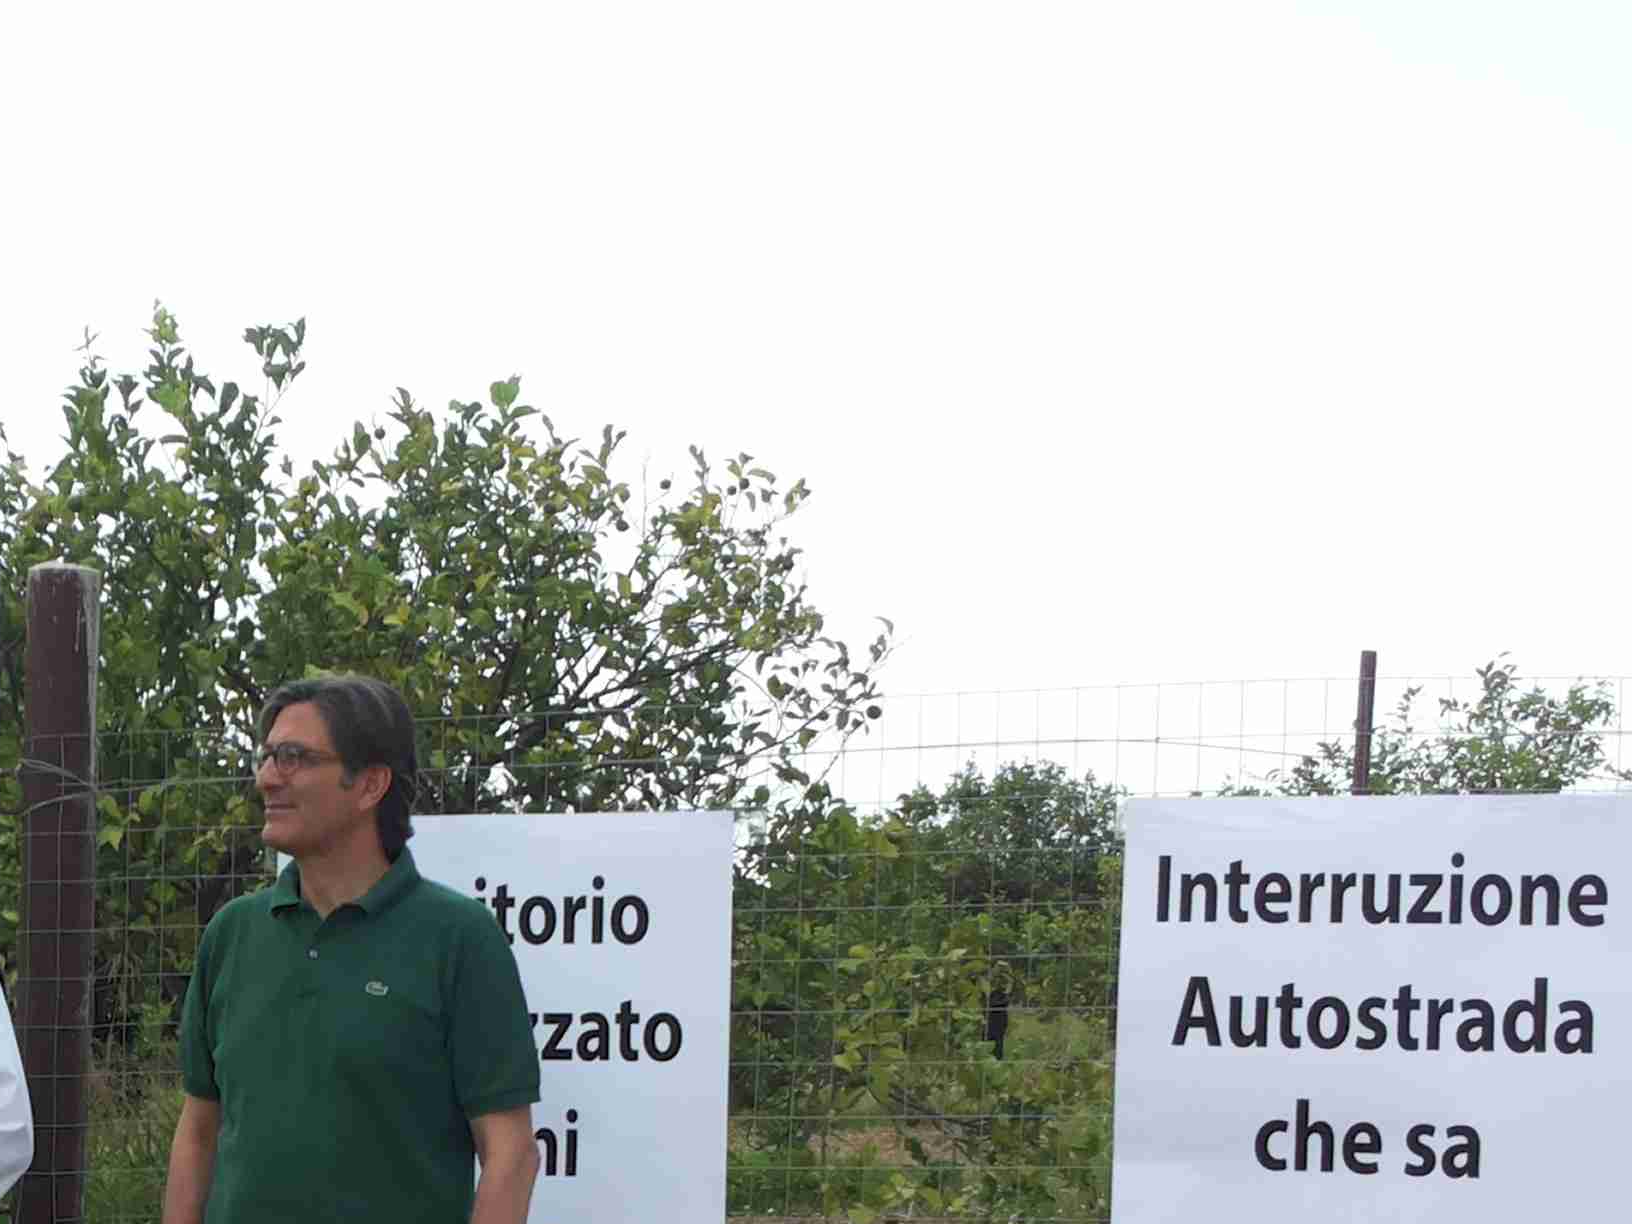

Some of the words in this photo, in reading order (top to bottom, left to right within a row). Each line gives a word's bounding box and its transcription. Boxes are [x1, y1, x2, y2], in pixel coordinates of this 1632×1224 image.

[1156, 852, 1608, 927] Interruzione
[1171, 976, 1594, 1055] Autostrada
[1254, 1098, 1383, 1175] che
[1404, 1123, 1481, 1179] sa
